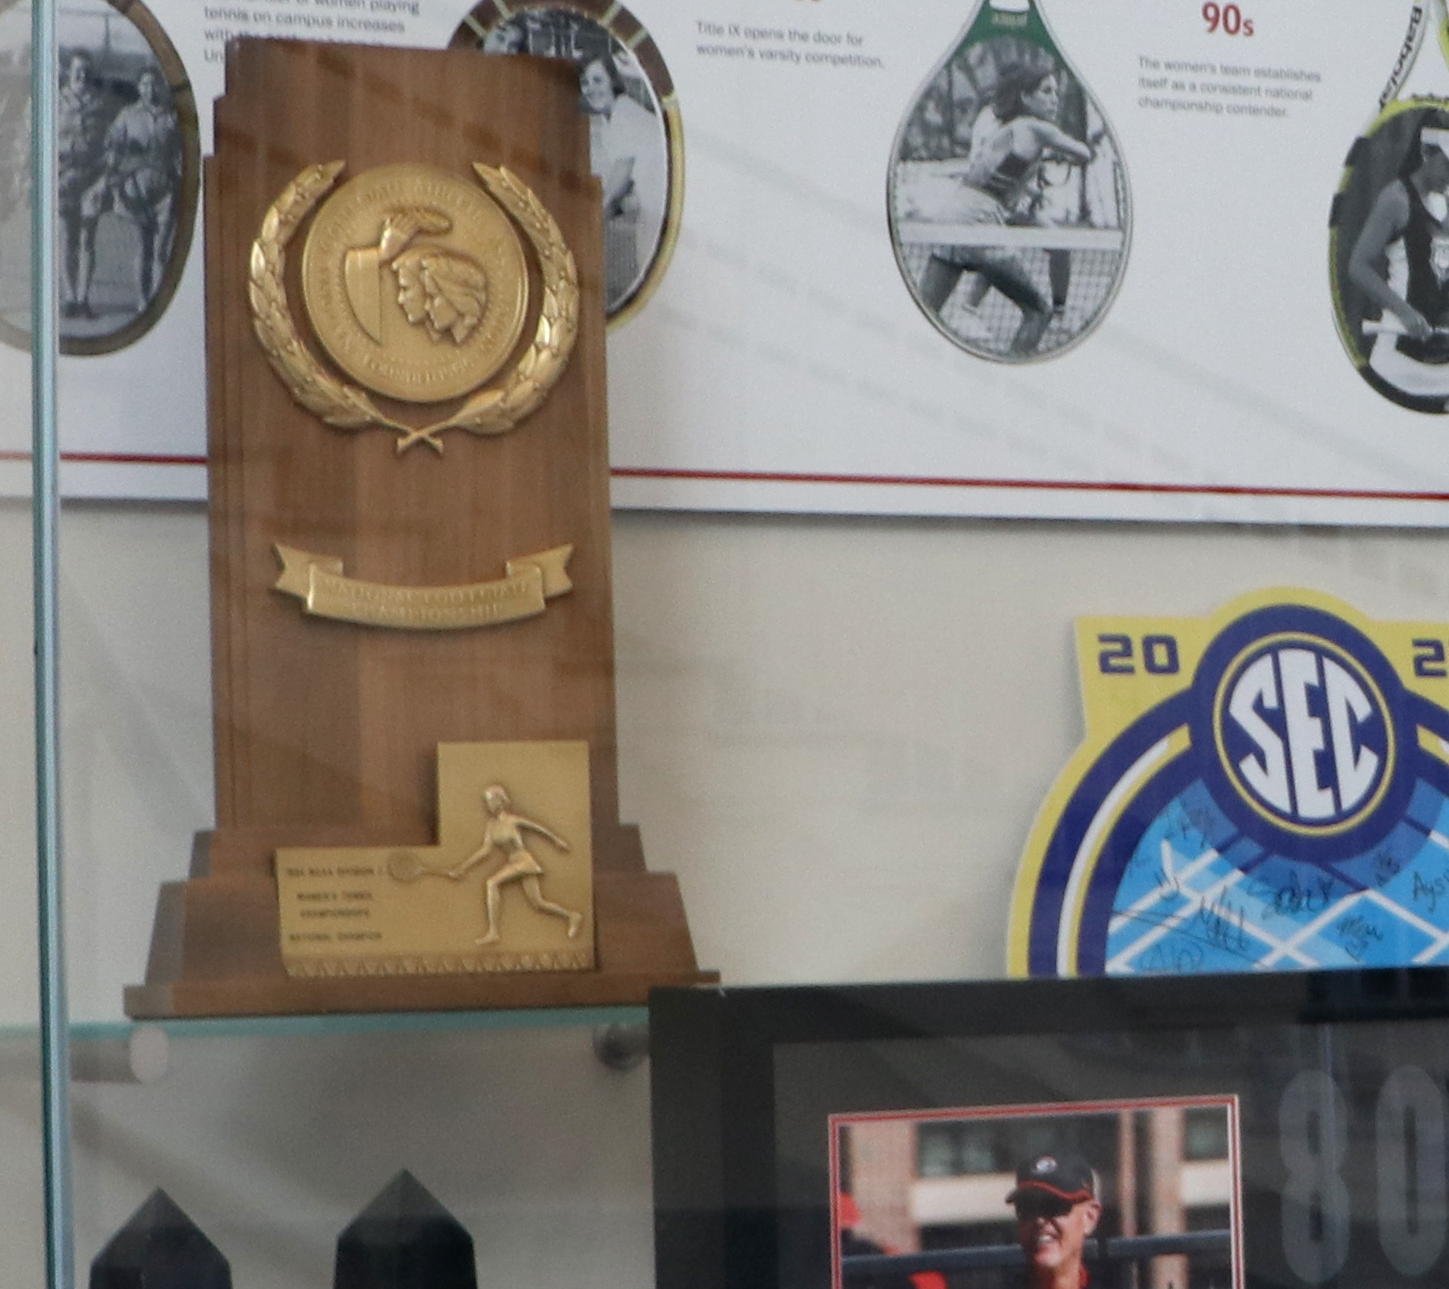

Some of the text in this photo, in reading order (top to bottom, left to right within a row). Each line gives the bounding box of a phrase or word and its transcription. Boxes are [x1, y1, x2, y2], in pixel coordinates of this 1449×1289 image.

[204, 6, 406, 32] tennis on campus increases
[1202, 1, 1254, 37] 90s
[696, 20, 726, 37] Title
[744, 27, 785, 42] opens
[788, 28, 810, 43] the
[813, 31, 843, 45] door
[846, 32, 863, 46] for
[696, 43, 884, 70] women's varsity competition.
[1138, 55, 1322, 83] The women's team establishes
[1138, 76, 1168, 90] itself
[1171, 80, 1186, 92] as
[1200, 82, 1262, 97] consistent
[1265, 86, 1313, 102] national
[1138, 96, 1288, 118] championship contender.
[1097, 633, 1181, 675] 20
[1229, 648, 1379, 819] SEC
